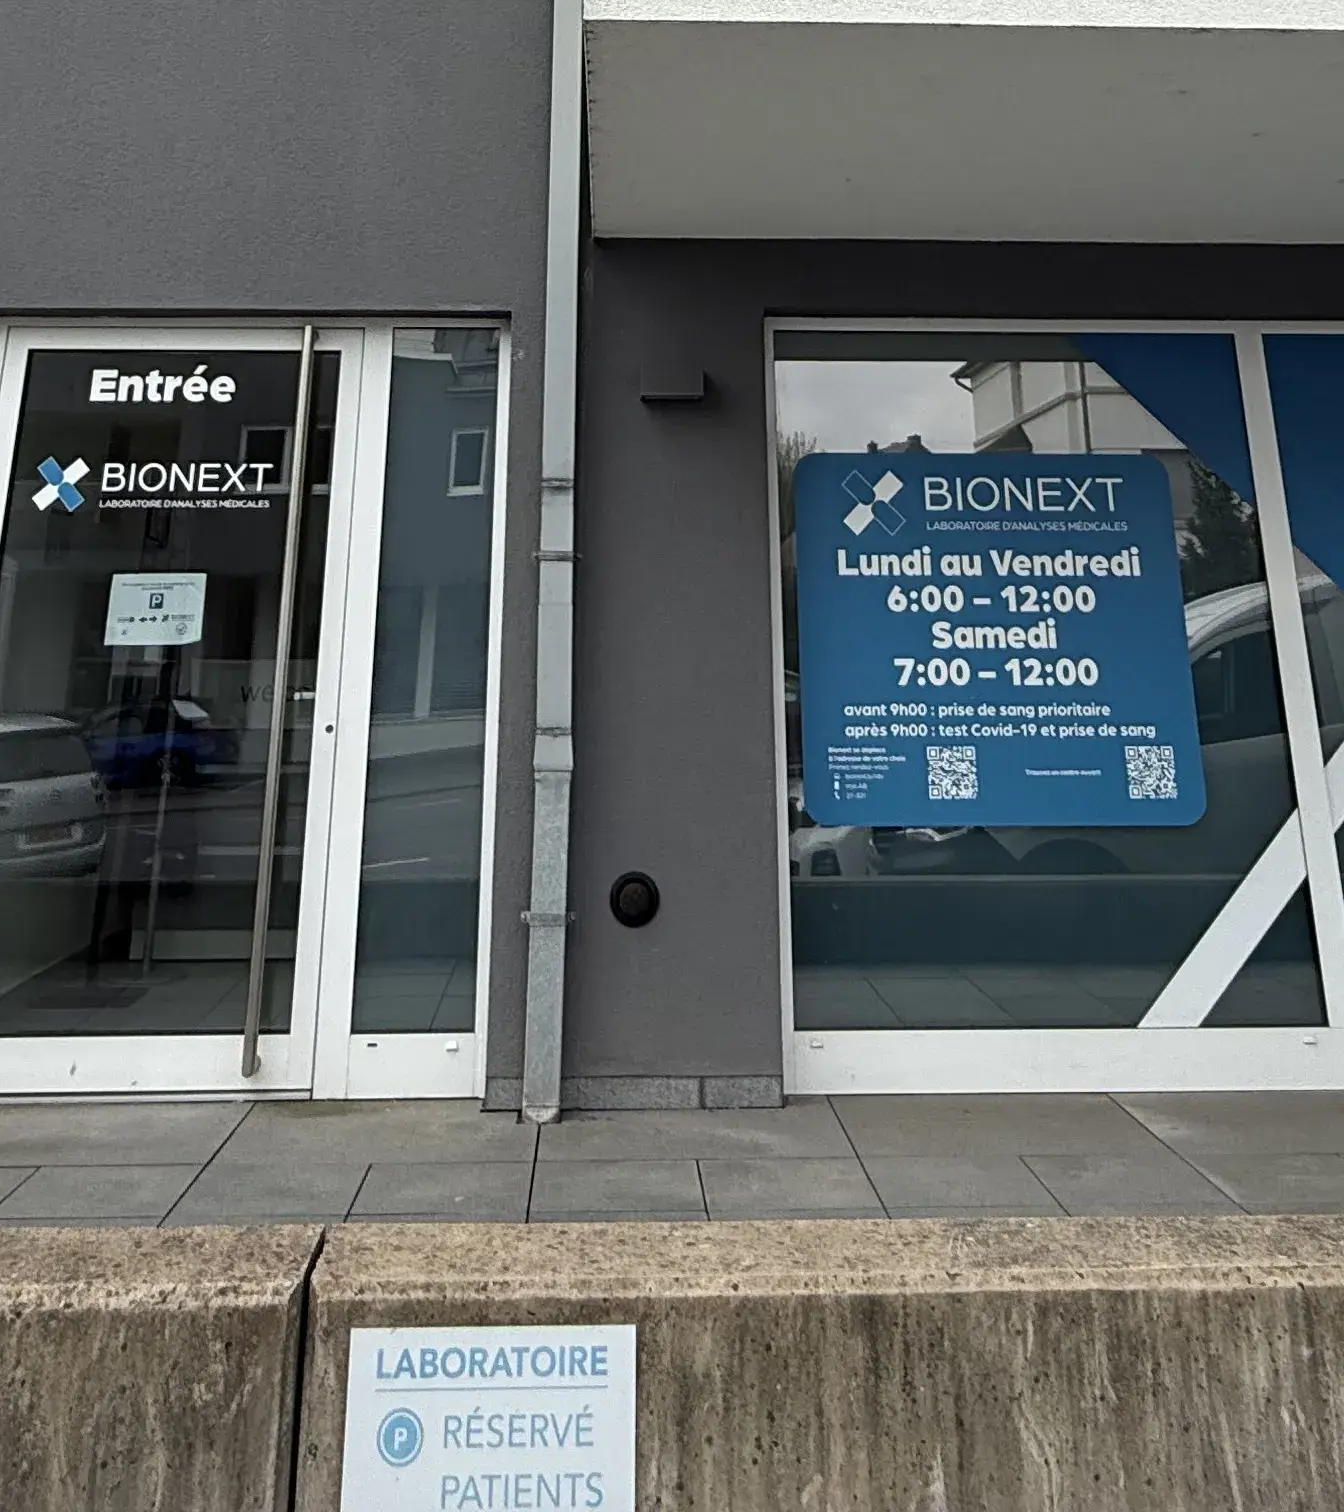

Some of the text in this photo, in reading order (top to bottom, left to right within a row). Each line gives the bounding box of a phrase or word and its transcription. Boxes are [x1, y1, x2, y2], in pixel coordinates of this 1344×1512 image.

[89, 365, 236, 403] Entrée
[101, 462, 274, 492] BIONEXT
[98, 499, 162, 509] LABORATOIRE
[218, 497, 270, 508] MÉDICALES
[923, 476, 1123, 512] BIONEXT
[926, 519, 1128, 531] LABORATOIRE D'ANALYSES MÉDICALES
[837, 545, 1142, 577] Lundi au Vendredi
[887, 584, 965, 614] 6:00
[1000, 584, 1097, 614] 12:00
[932, 617, 1058, 650] Samedi
[893, 658, 971, 687] 7:00
[1004, 658, 1100, 687] 12:00
[843, 703, 888, 717] avant
[889, 702, 928, 717] 9h00
[938, 702, 975, 719] prise
[977, 703, 997, 717] de
[999, 705, 1035, 719] sang
[1038, 702, 1112, 719] prioritaire
[844, 723, 888, 739] après
[890, 723, 929, 737] 9h00
[938, 724, 969, 737] test
[1040, 724, 1057, 737] et
[1058, 722, 1096, 739] prise
[1097, 723, 1118, 737] de
[1120, 725, 1156, 739] sang
[376, 1345, 609, 1380] LABORATOIRE
[443, 1404, 595, 1450] RÉSERVÉ
[440, 1472, 605, 1511] PATIENTS
